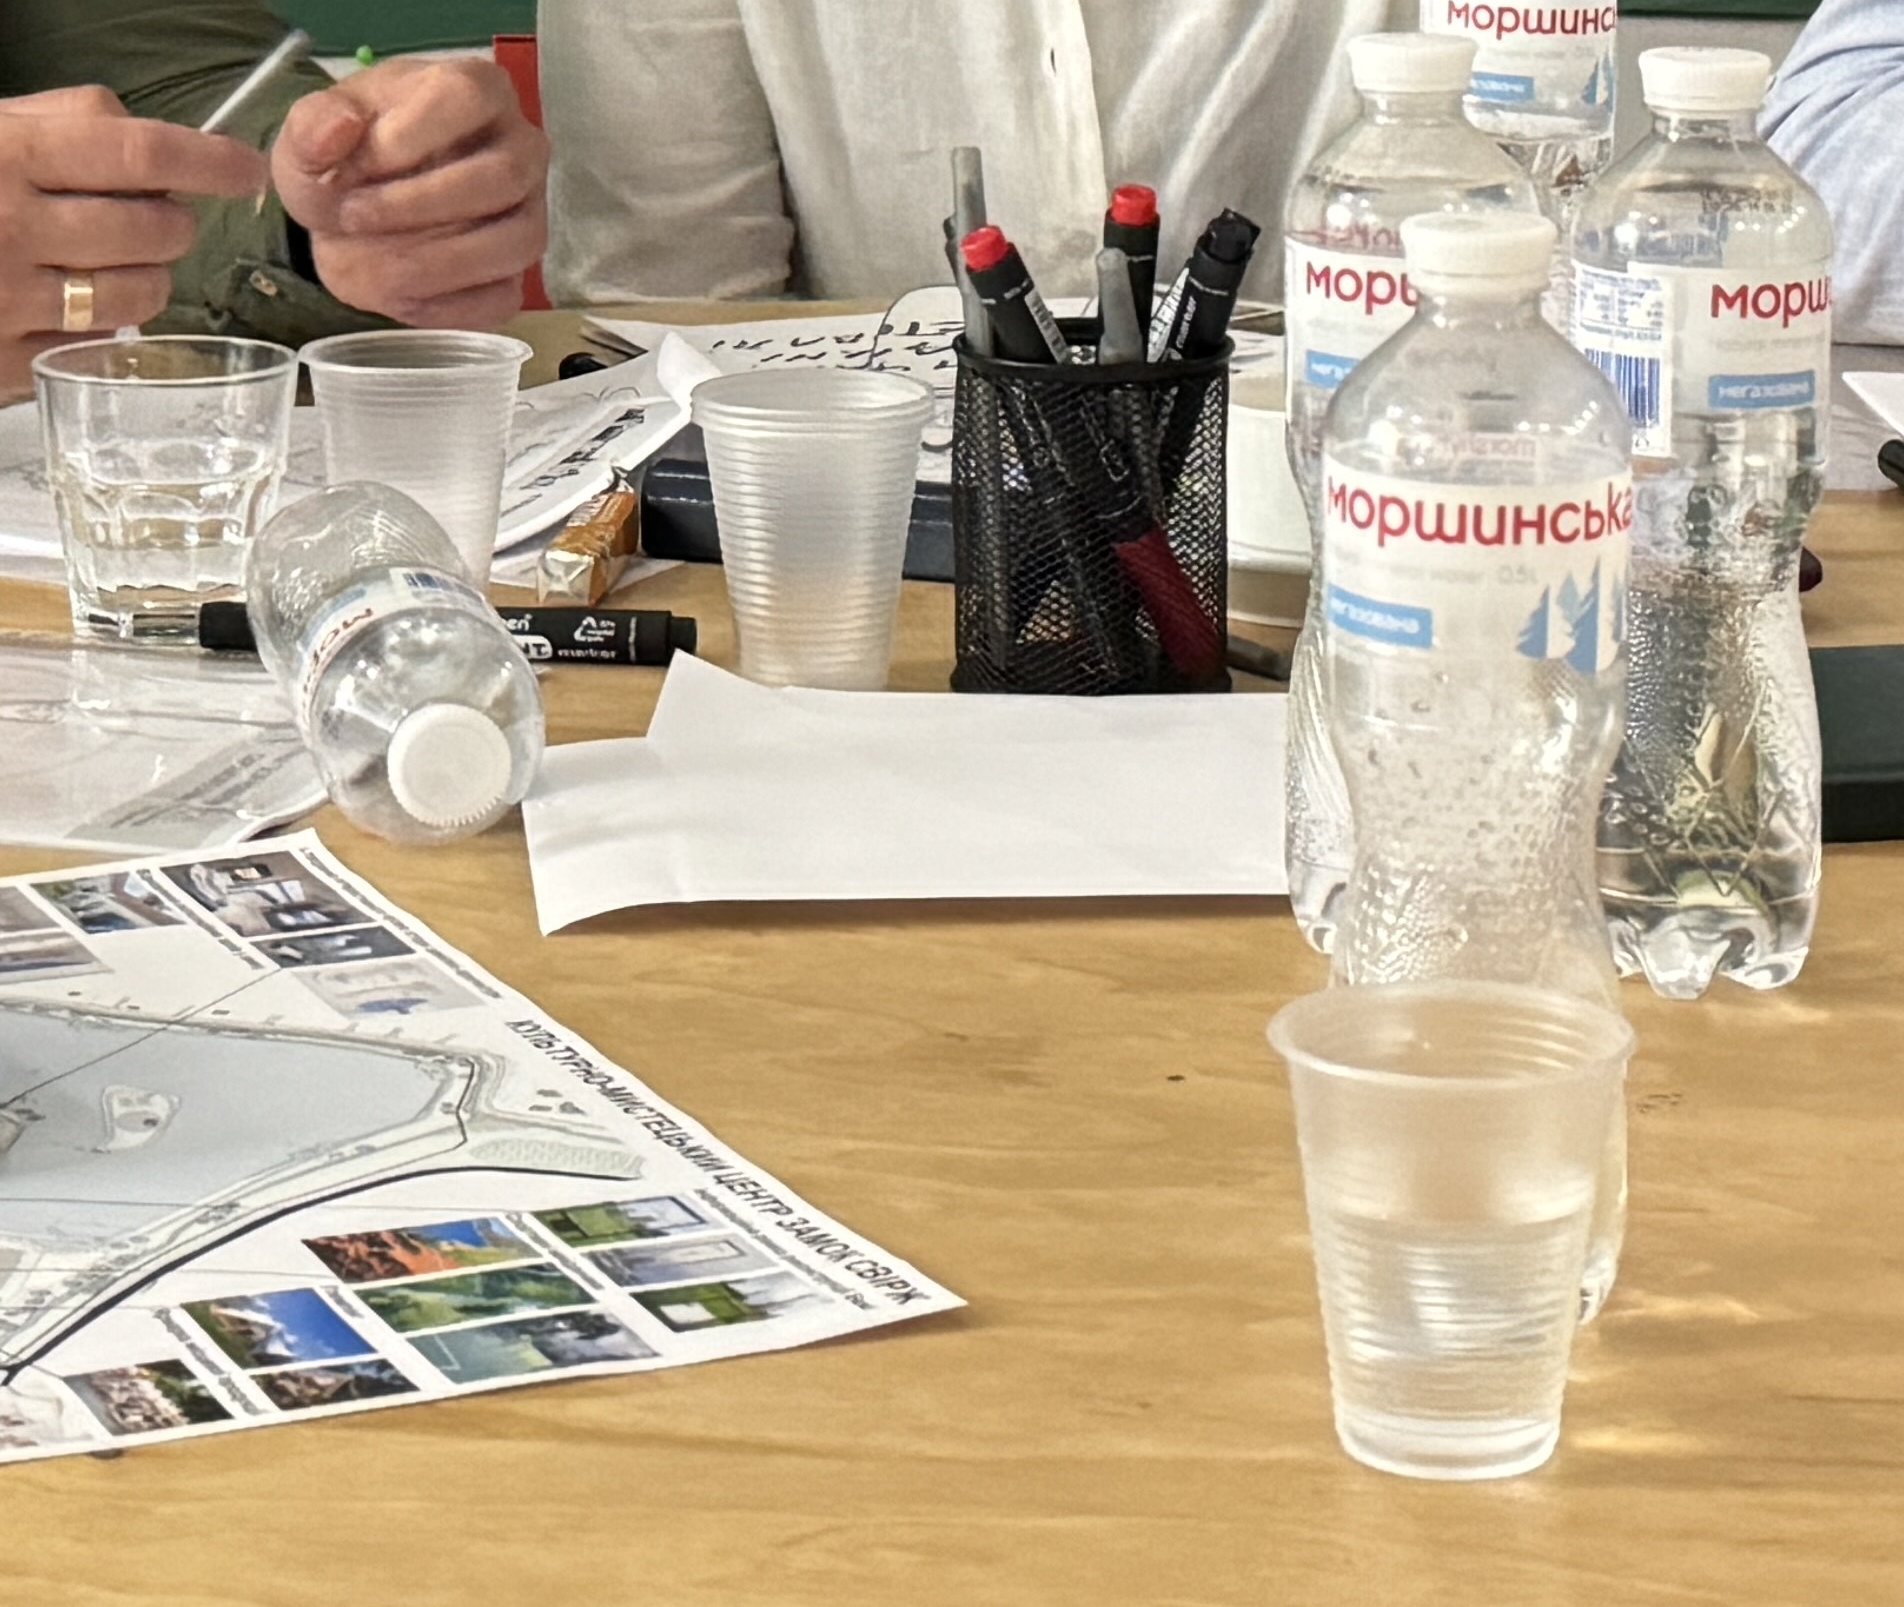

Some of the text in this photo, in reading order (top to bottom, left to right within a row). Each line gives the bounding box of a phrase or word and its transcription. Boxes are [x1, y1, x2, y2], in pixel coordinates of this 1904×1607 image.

[1447, 0, 1616, 41] моршинс
[1710, 273, 1833, 329] морш
[1328, 475, 1633, 548] моршинська
[712, 1171, 794, 1219] ЦЕНТР
[776, 1217, 865, 1265] ЗАМОК
[845, 1258, 932, 1306] СВІРЖ
